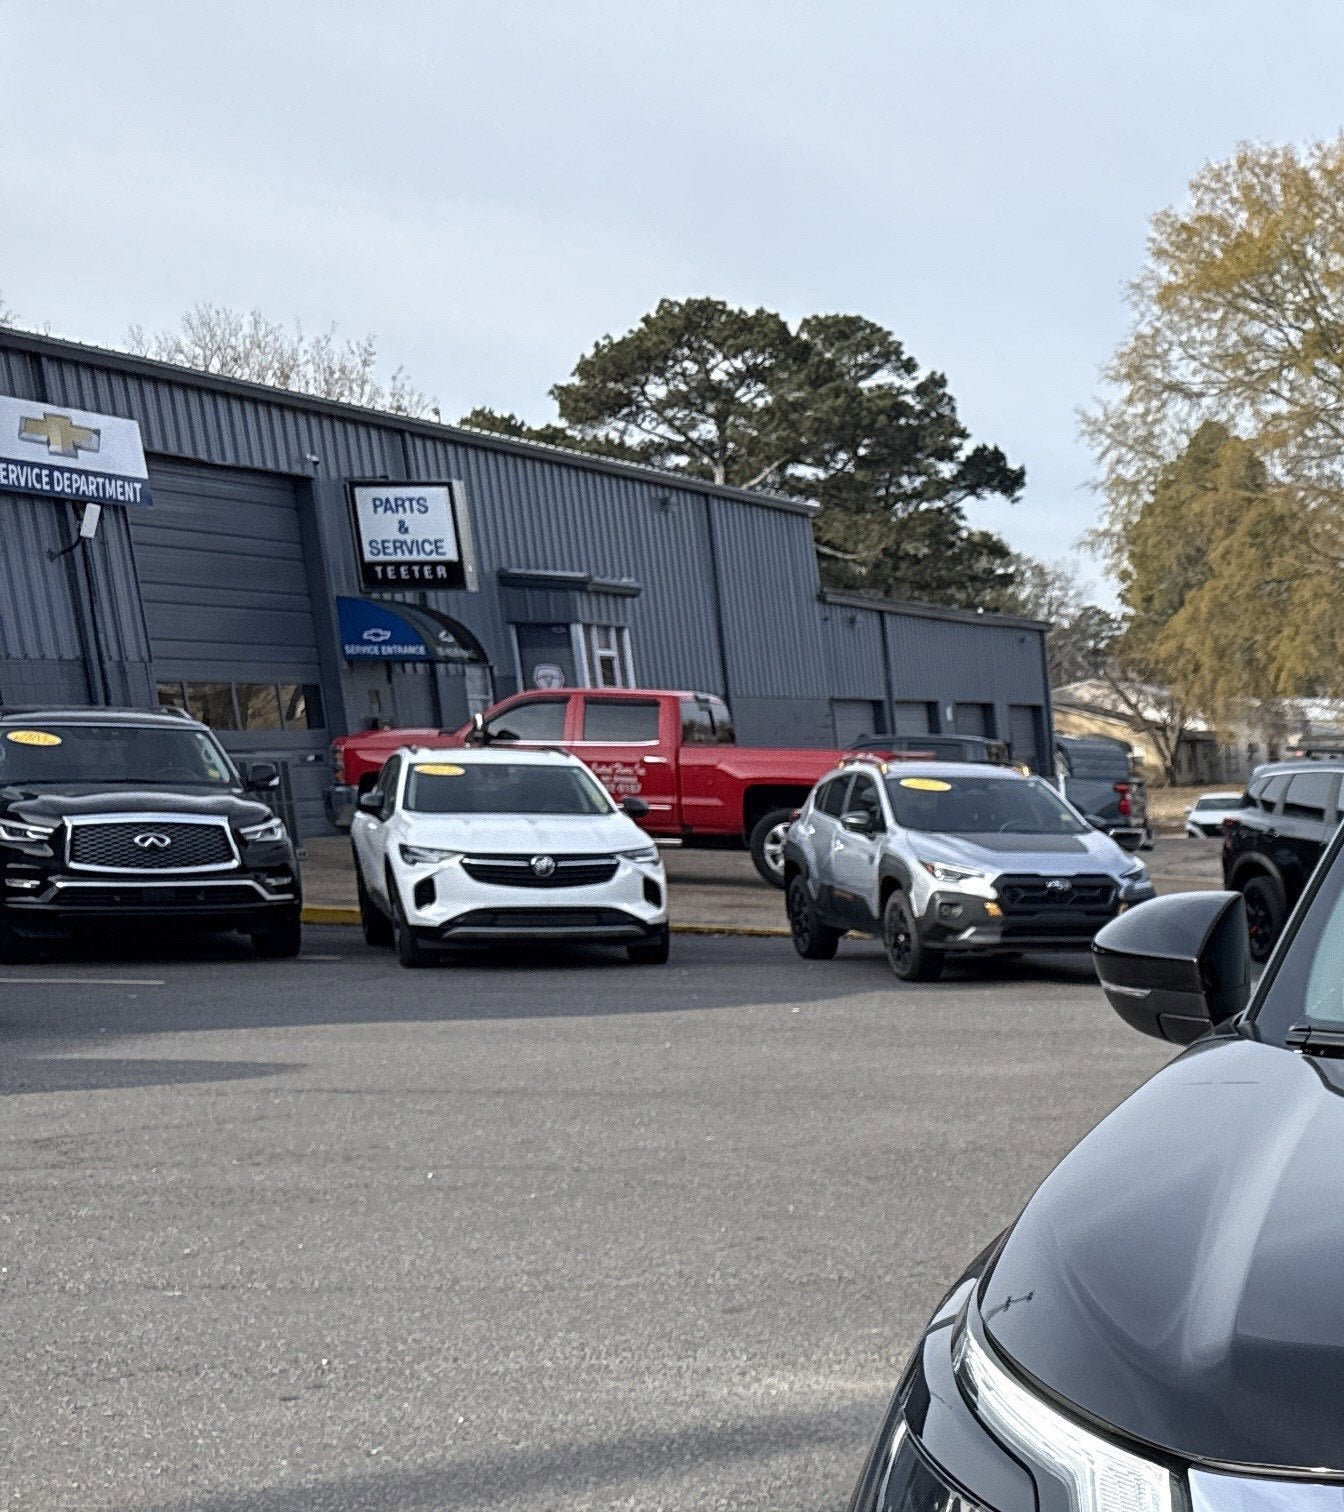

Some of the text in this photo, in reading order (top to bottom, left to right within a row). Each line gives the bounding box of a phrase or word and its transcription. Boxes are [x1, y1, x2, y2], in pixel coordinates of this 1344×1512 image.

[0, 463, 142, 502] ERVICE DEPARTMENT
[372, 496, 429, 515] PARTS
[398, 519, 410, 535] &
[368, 538, 447, 556] SERVICE
[374, 565, 448, 579] TEETER
